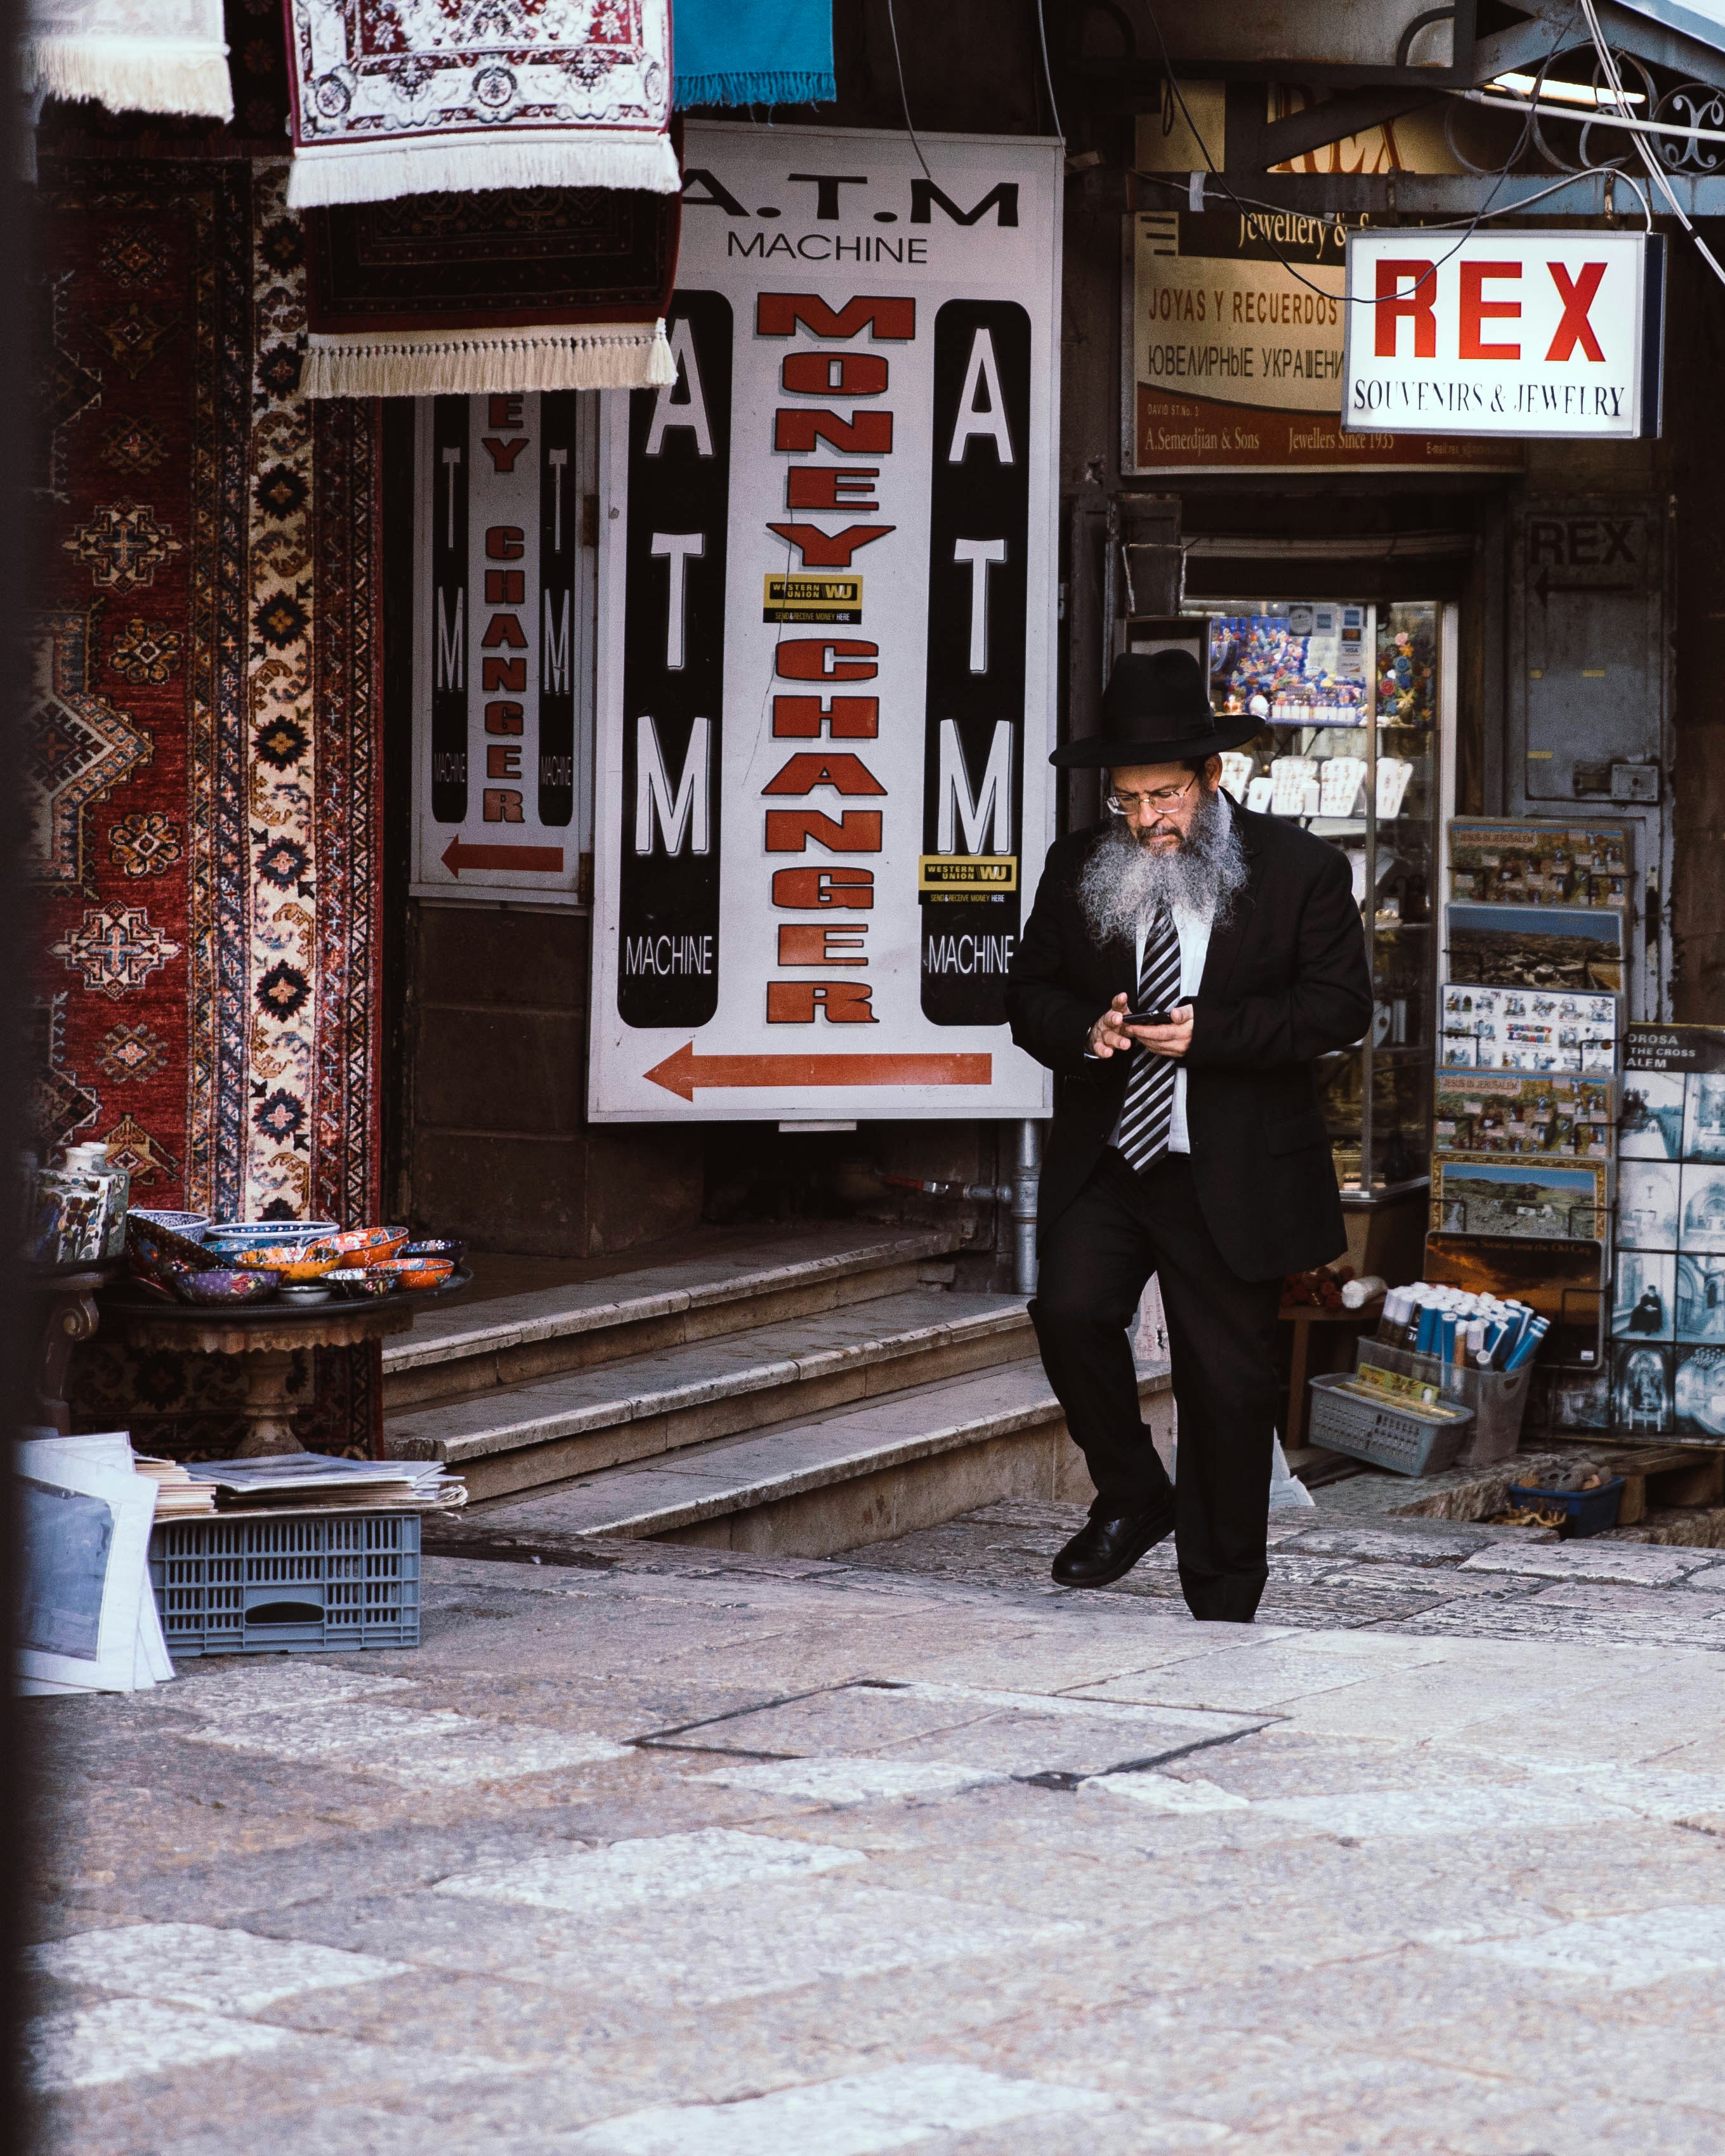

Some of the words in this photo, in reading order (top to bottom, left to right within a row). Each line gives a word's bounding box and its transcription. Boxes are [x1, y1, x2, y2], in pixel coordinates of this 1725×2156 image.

[728, 231, 927, 264] MACHINE
[1238, 212, 1328, 259] Jewellery
[1149, 288, 1205, 322] JOYAS
[1214, 290, 1224, 322] Y
[1233, 291, 1337, 325] RECUERDOS
[1374, 259, 1608, 362] REX
[1149, 344, 1254, 377] ЮВЕЛИРНЫЕ
[1147, 404, 1169, 415] DAVID
[1195, 405, 1198, 416] 3
[1354, 379, 1483, 412] SOUVENIRS
[1490, 384, 1506, 412] &
[1514, 384, 1625, 416] JEWELRY
[756, 291, 916, 567] MONEY
[1221, 428, 1232, 449] &
[1235, 426, 1259, 449] Sons
[1289, 428, 1335, 454] Jewellers
[1338, 430, 1366, 449] Since
[1530, 520, 1637, 565] REX
[825, 584, 852, 599] WU
[836, 613, 851, 621] HERE
[480, 525, 530, 823] CHANGER
[761, 638, 889, 1024] CHANGER
[980, 866, 1007, 880] WU
[992, 894, 1006, 903] HERE
[626, 935, 713, 975] MACHINE
[928, 934, 1014, 974] MACHINE
[1656, 1049, 1696, 1057] CROSS
